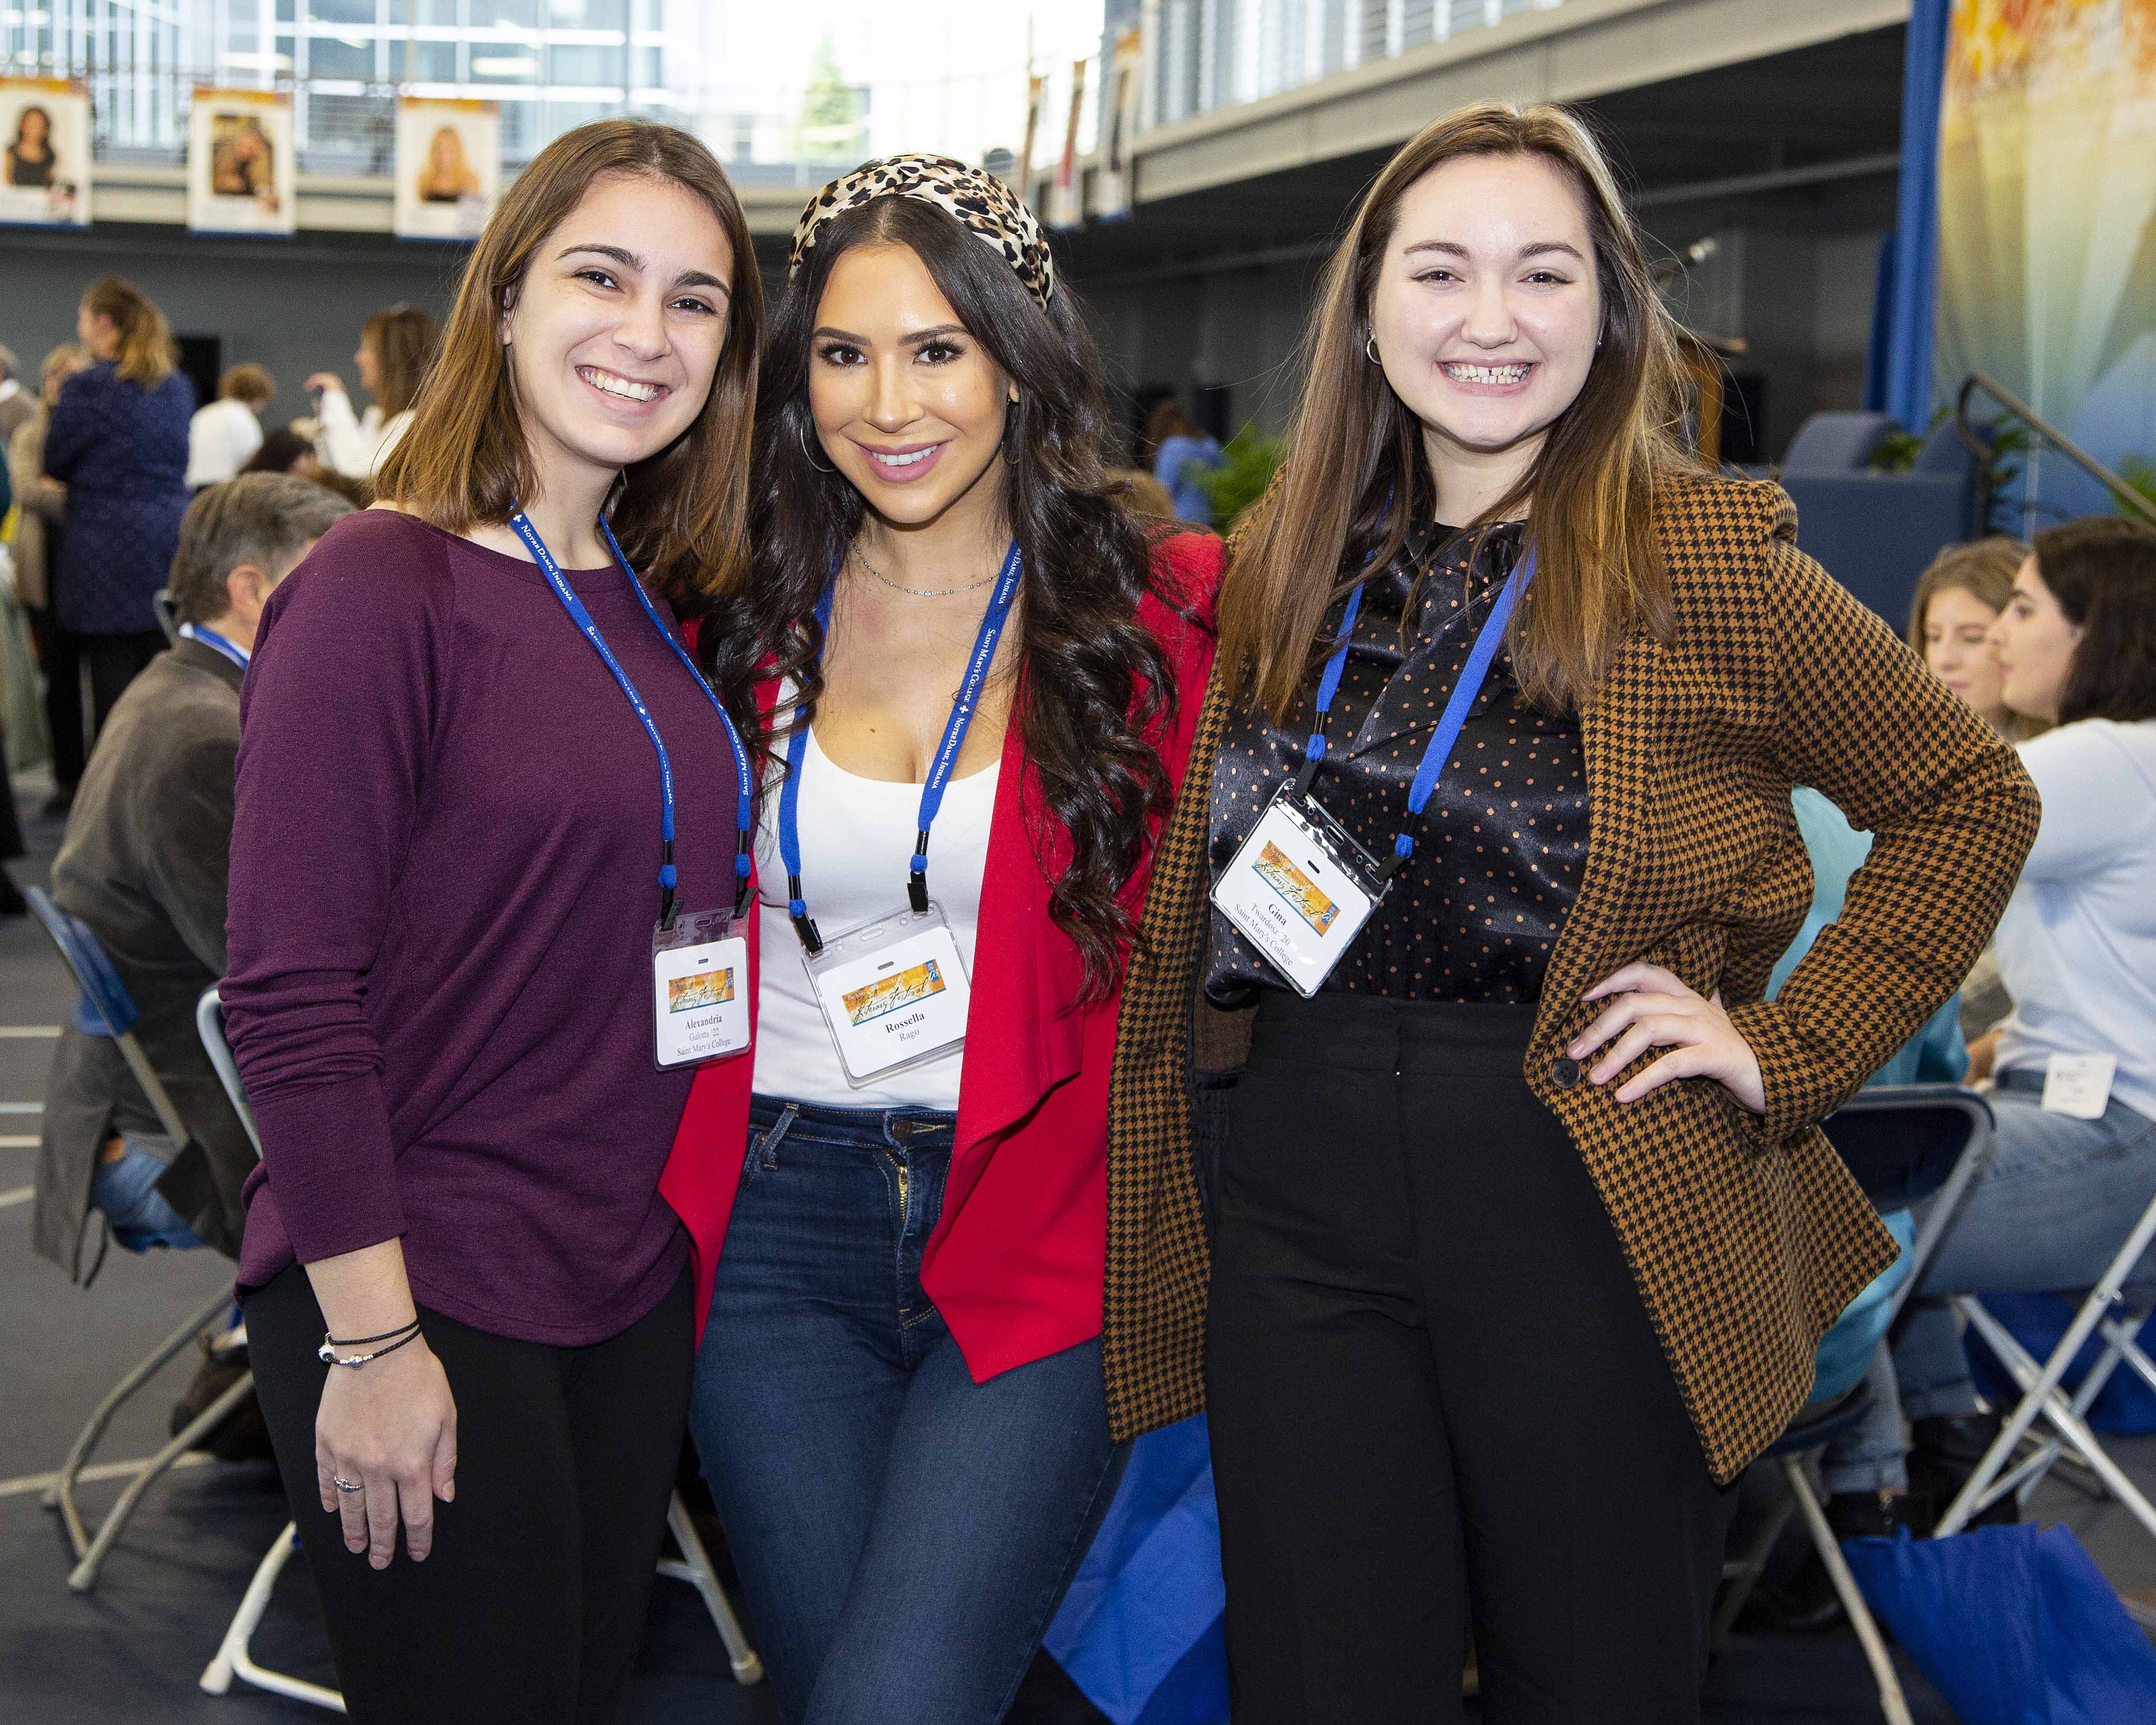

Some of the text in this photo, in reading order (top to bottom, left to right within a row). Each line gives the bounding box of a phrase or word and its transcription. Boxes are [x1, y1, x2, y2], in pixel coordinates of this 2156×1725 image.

[552, 571, 573, 601] INDIANA
[998, 577, 1014, 604] INDIANA
[982, 628, 996, 649] SAINT
[973, 648, 989, 673] MARY'S
[931, 761, 949, 789] INDIANA
[1251, 903, 1279, 935] Twardosz
[1268, 904, 1287, 925] Gina
[1235, 903, 1293, 966] Saint Mary's College
[685, 1014, 722, 1030] Alexandria
[886, 1013, 925, 1034] Rossella
[689, 1031, 709, 1041] Gulotta
[899, 1029, 920, 1042] Rago
[677, 1038, 731, 1056] Saint Mary's College
